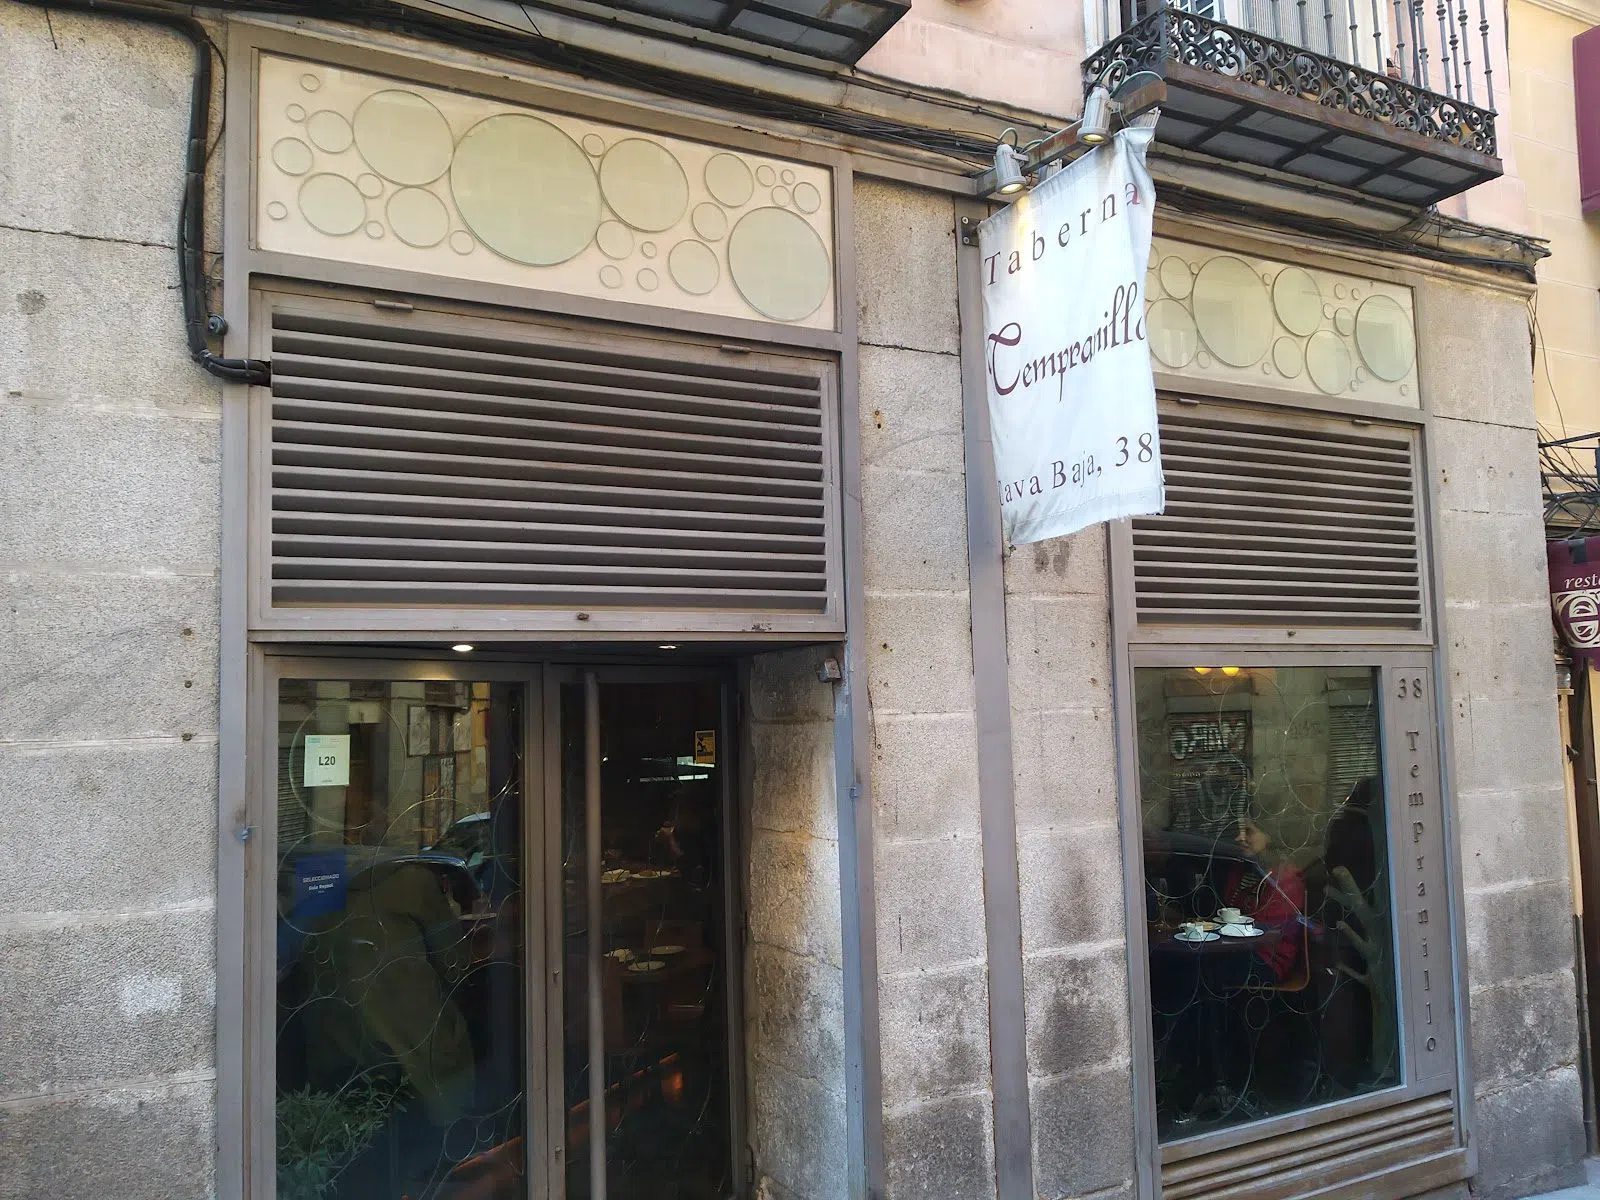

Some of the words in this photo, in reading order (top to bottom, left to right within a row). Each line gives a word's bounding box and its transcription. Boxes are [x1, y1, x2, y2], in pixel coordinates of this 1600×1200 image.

[984, 182, 1140, 286] Taberna
[1051, 450, 1102, 489] Baja,
[1115, 432, 1153, 467] 38
[1563, 573, 1600, 589] rest
[1397, 678, 1422, 698] 38
[318, 755, 336, 766] L20
[1405, 730, 1436, 1052] Tempranillo
